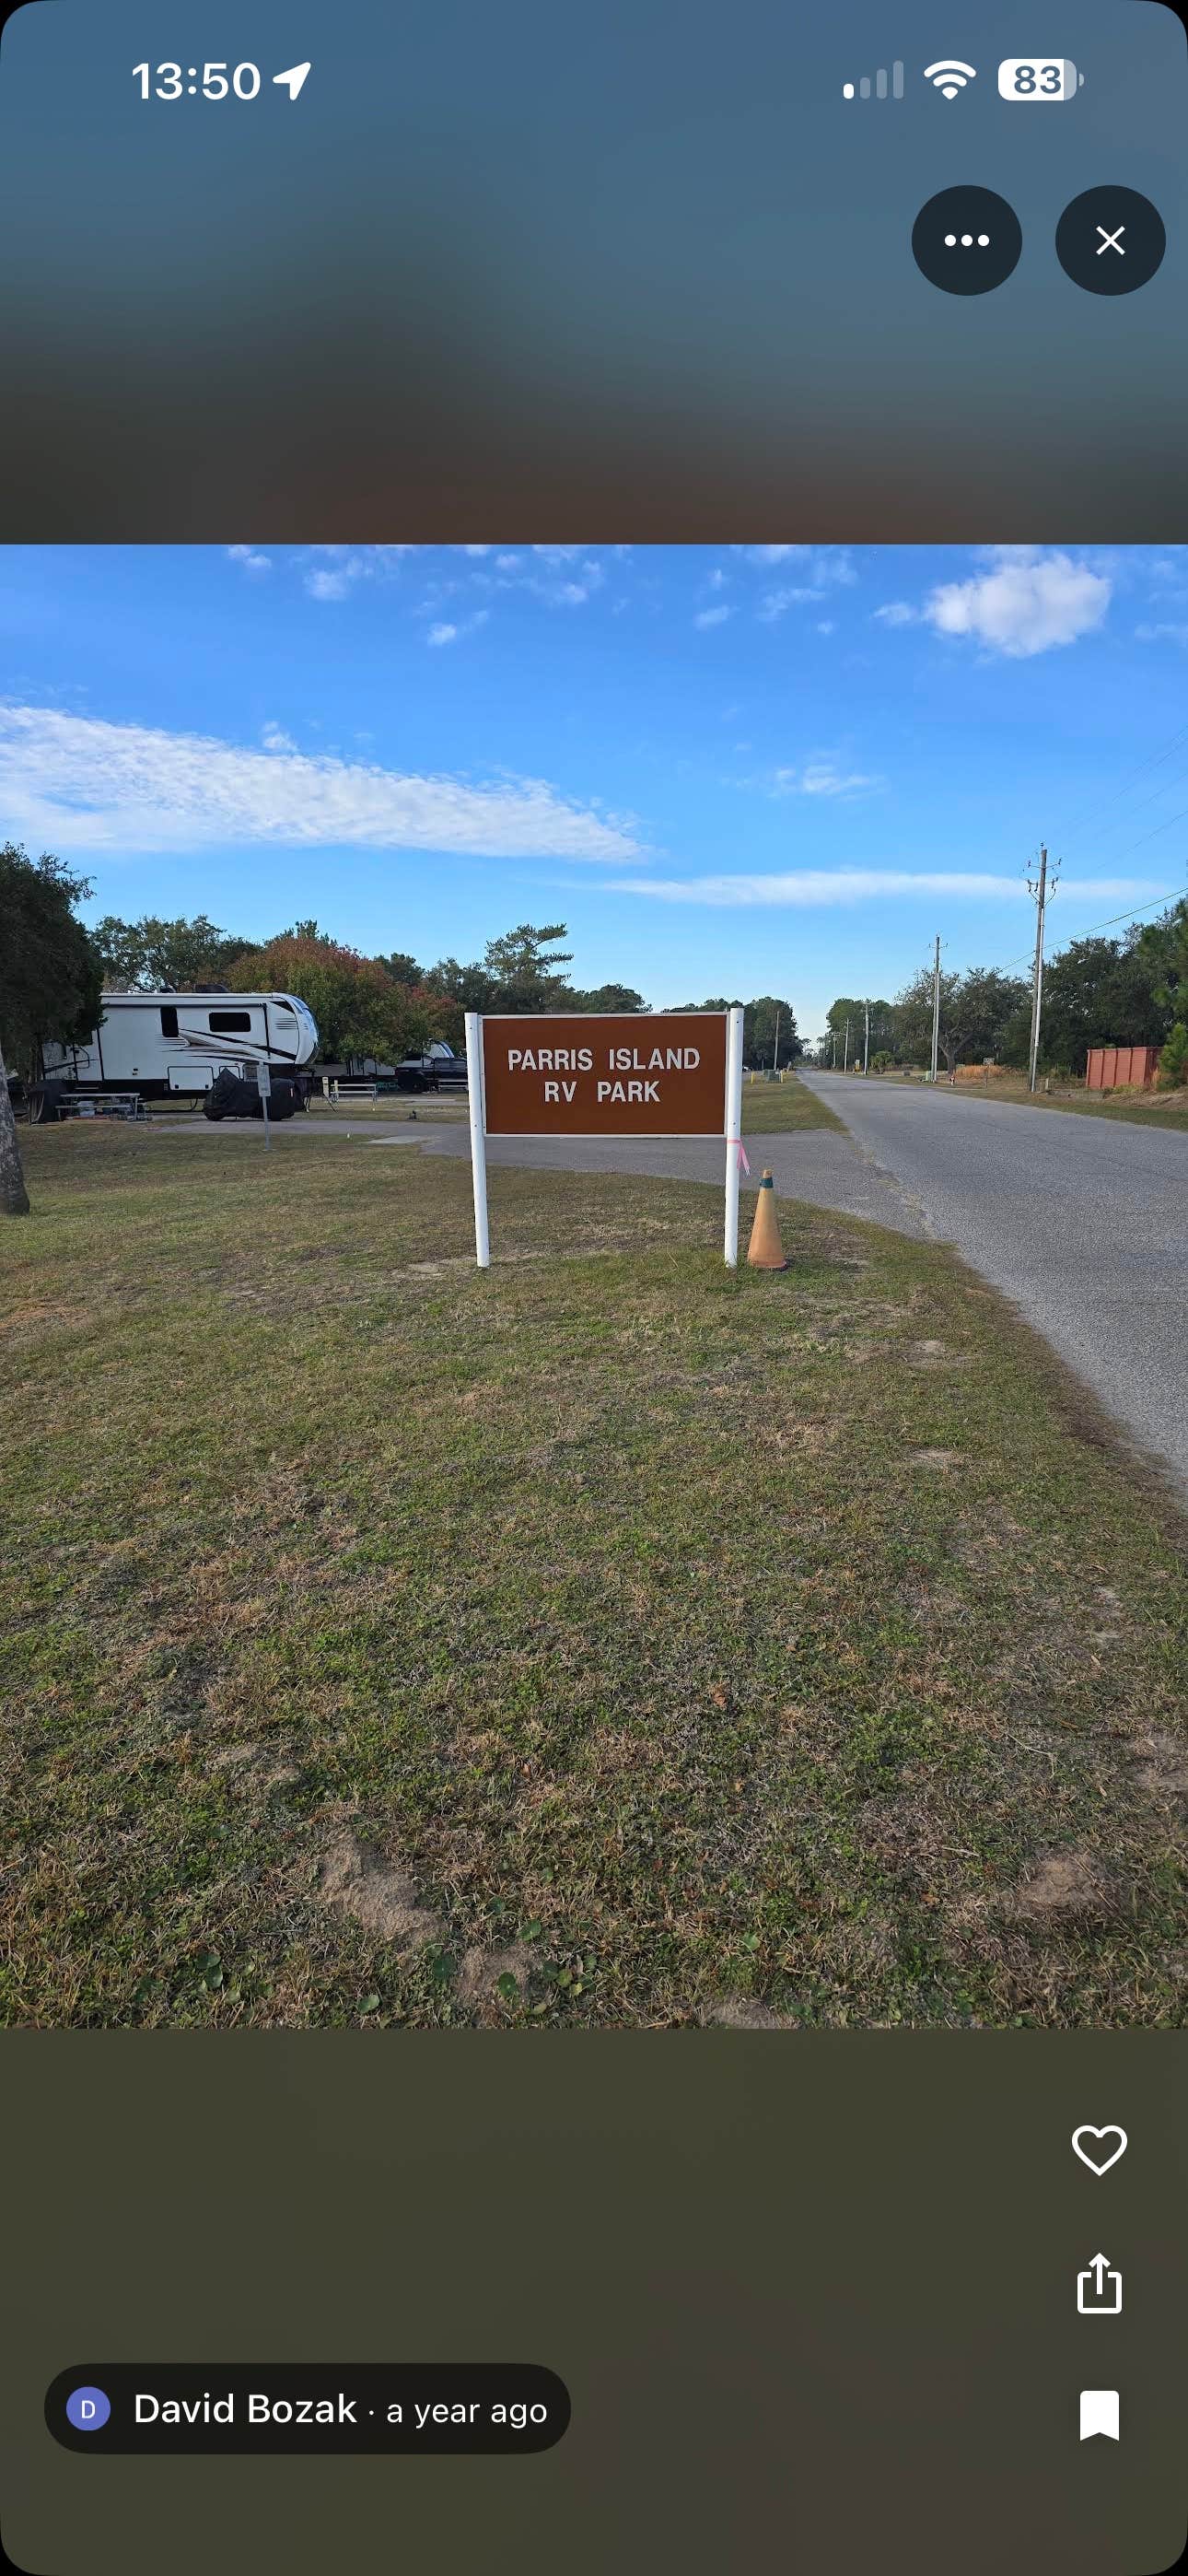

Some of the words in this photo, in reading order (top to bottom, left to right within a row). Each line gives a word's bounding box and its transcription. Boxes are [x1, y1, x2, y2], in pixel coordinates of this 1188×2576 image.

[507, 1048, 592, 1071] PARRIS
[609, 1048, 700, 1071] ISLAND
[544, 1081, 577, 1103] RV
[597, 1081, 660, 1103] PARK
